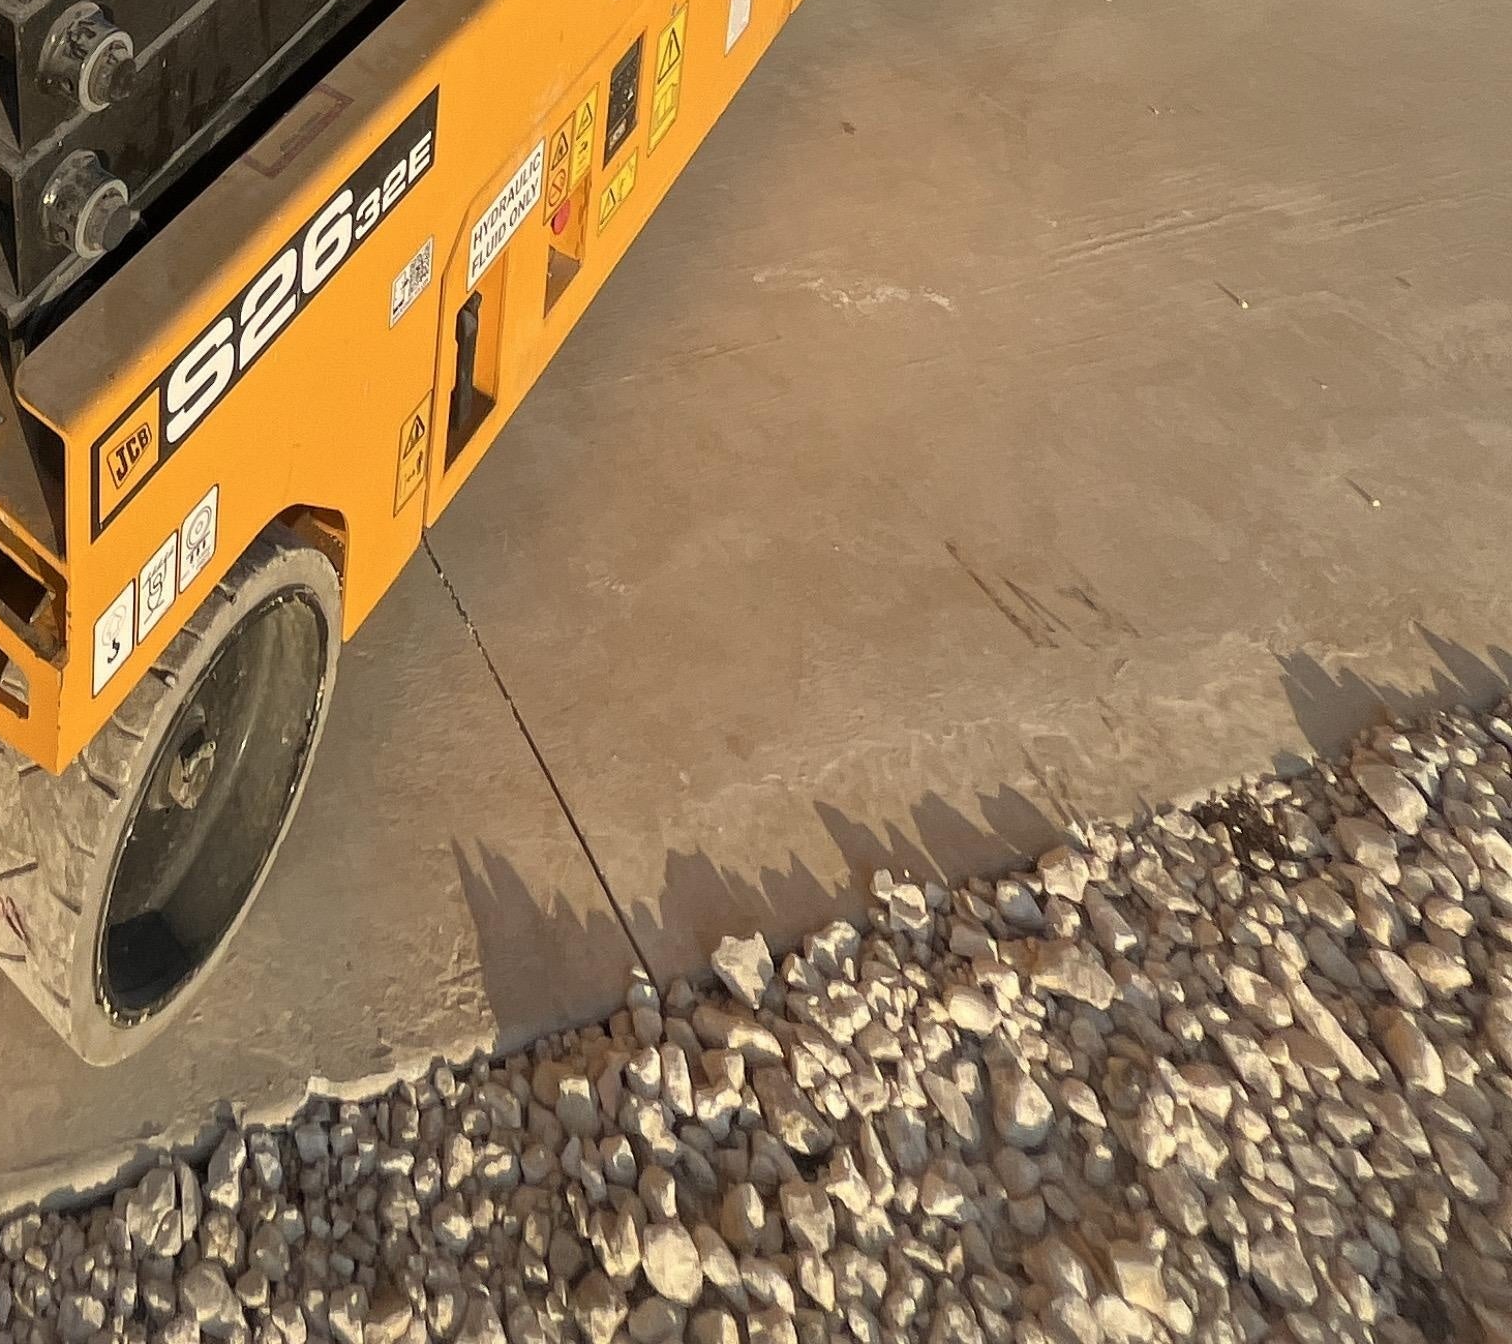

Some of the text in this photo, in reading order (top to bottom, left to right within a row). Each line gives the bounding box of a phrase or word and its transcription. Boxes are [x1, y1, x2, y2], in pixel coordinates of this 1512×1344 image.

[471, 177, 540, 279] FLUID ONLY
[473, 151, 541, 251] HYDRAULIC
[115, 425, 152, 483] JCB
